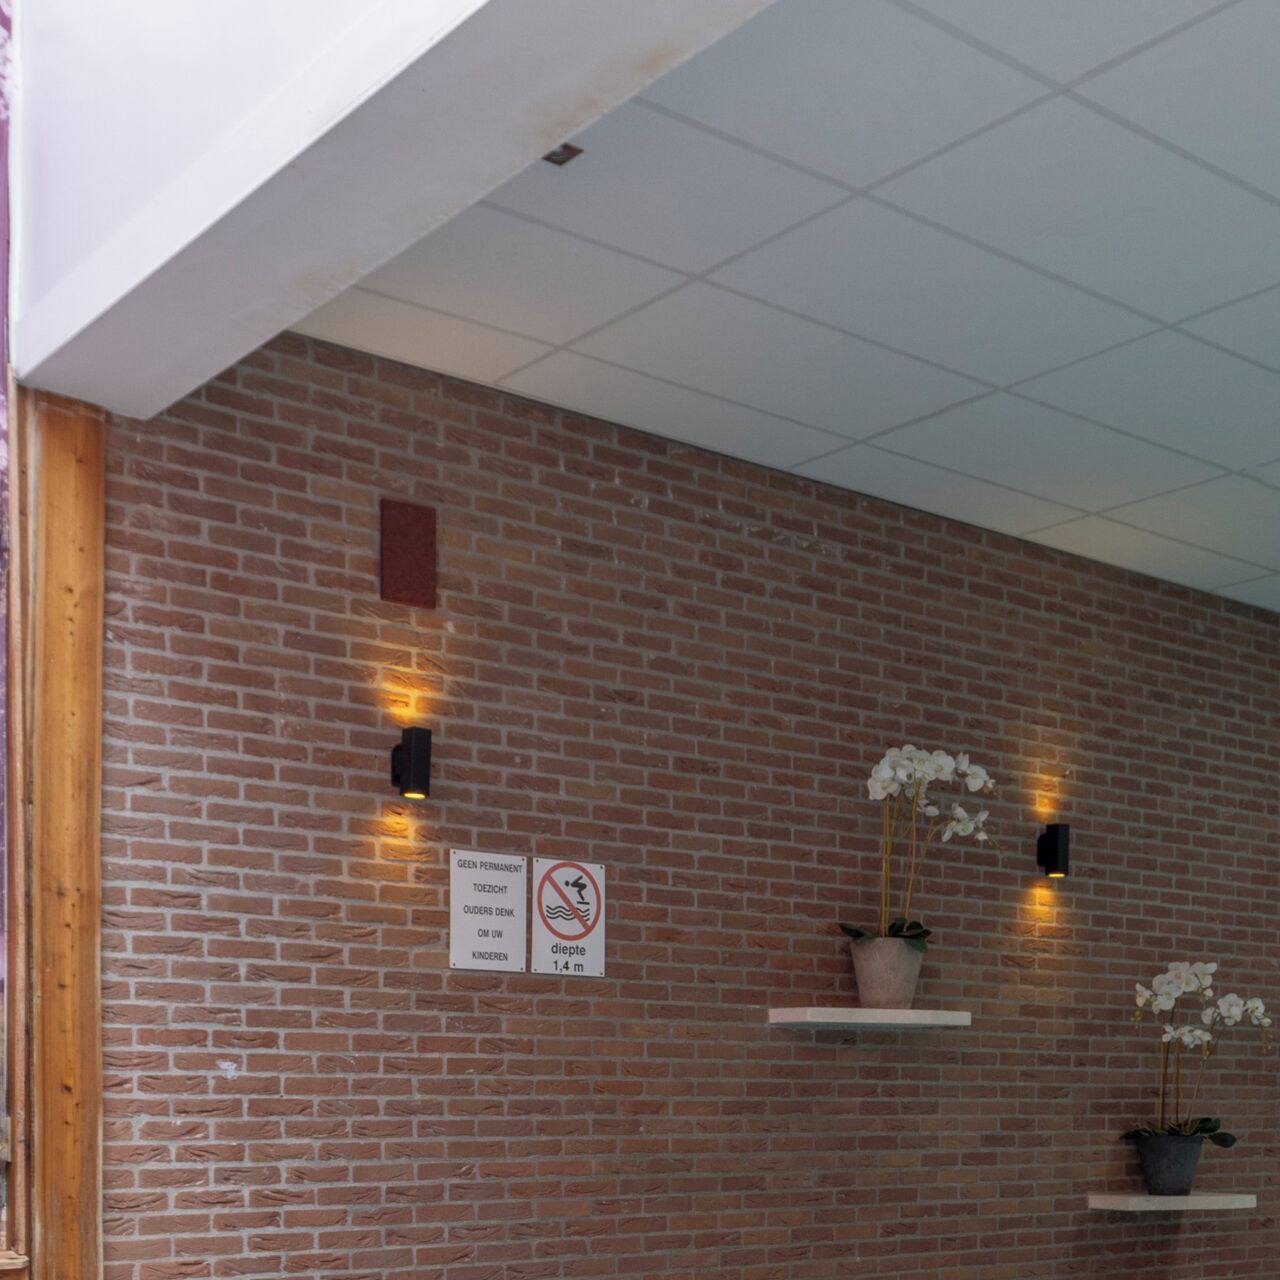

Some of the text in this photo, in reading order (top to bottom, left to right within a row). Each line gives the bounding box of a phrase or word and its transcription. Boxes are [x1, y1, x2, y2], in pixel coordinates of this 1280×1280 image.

[457, 859, 523, 873] GEEN PERMANENT
[473, 883, 508, 894] TOEZICHT
[463, 905, 515, 917] OUDERS DENK
[478, 928, 503, 938] OM UW
[472, 951, 508, 961] KINDEREN
[551, 943, 586, 957] diepte
[553, 960, 584, 973] 1,4 m
